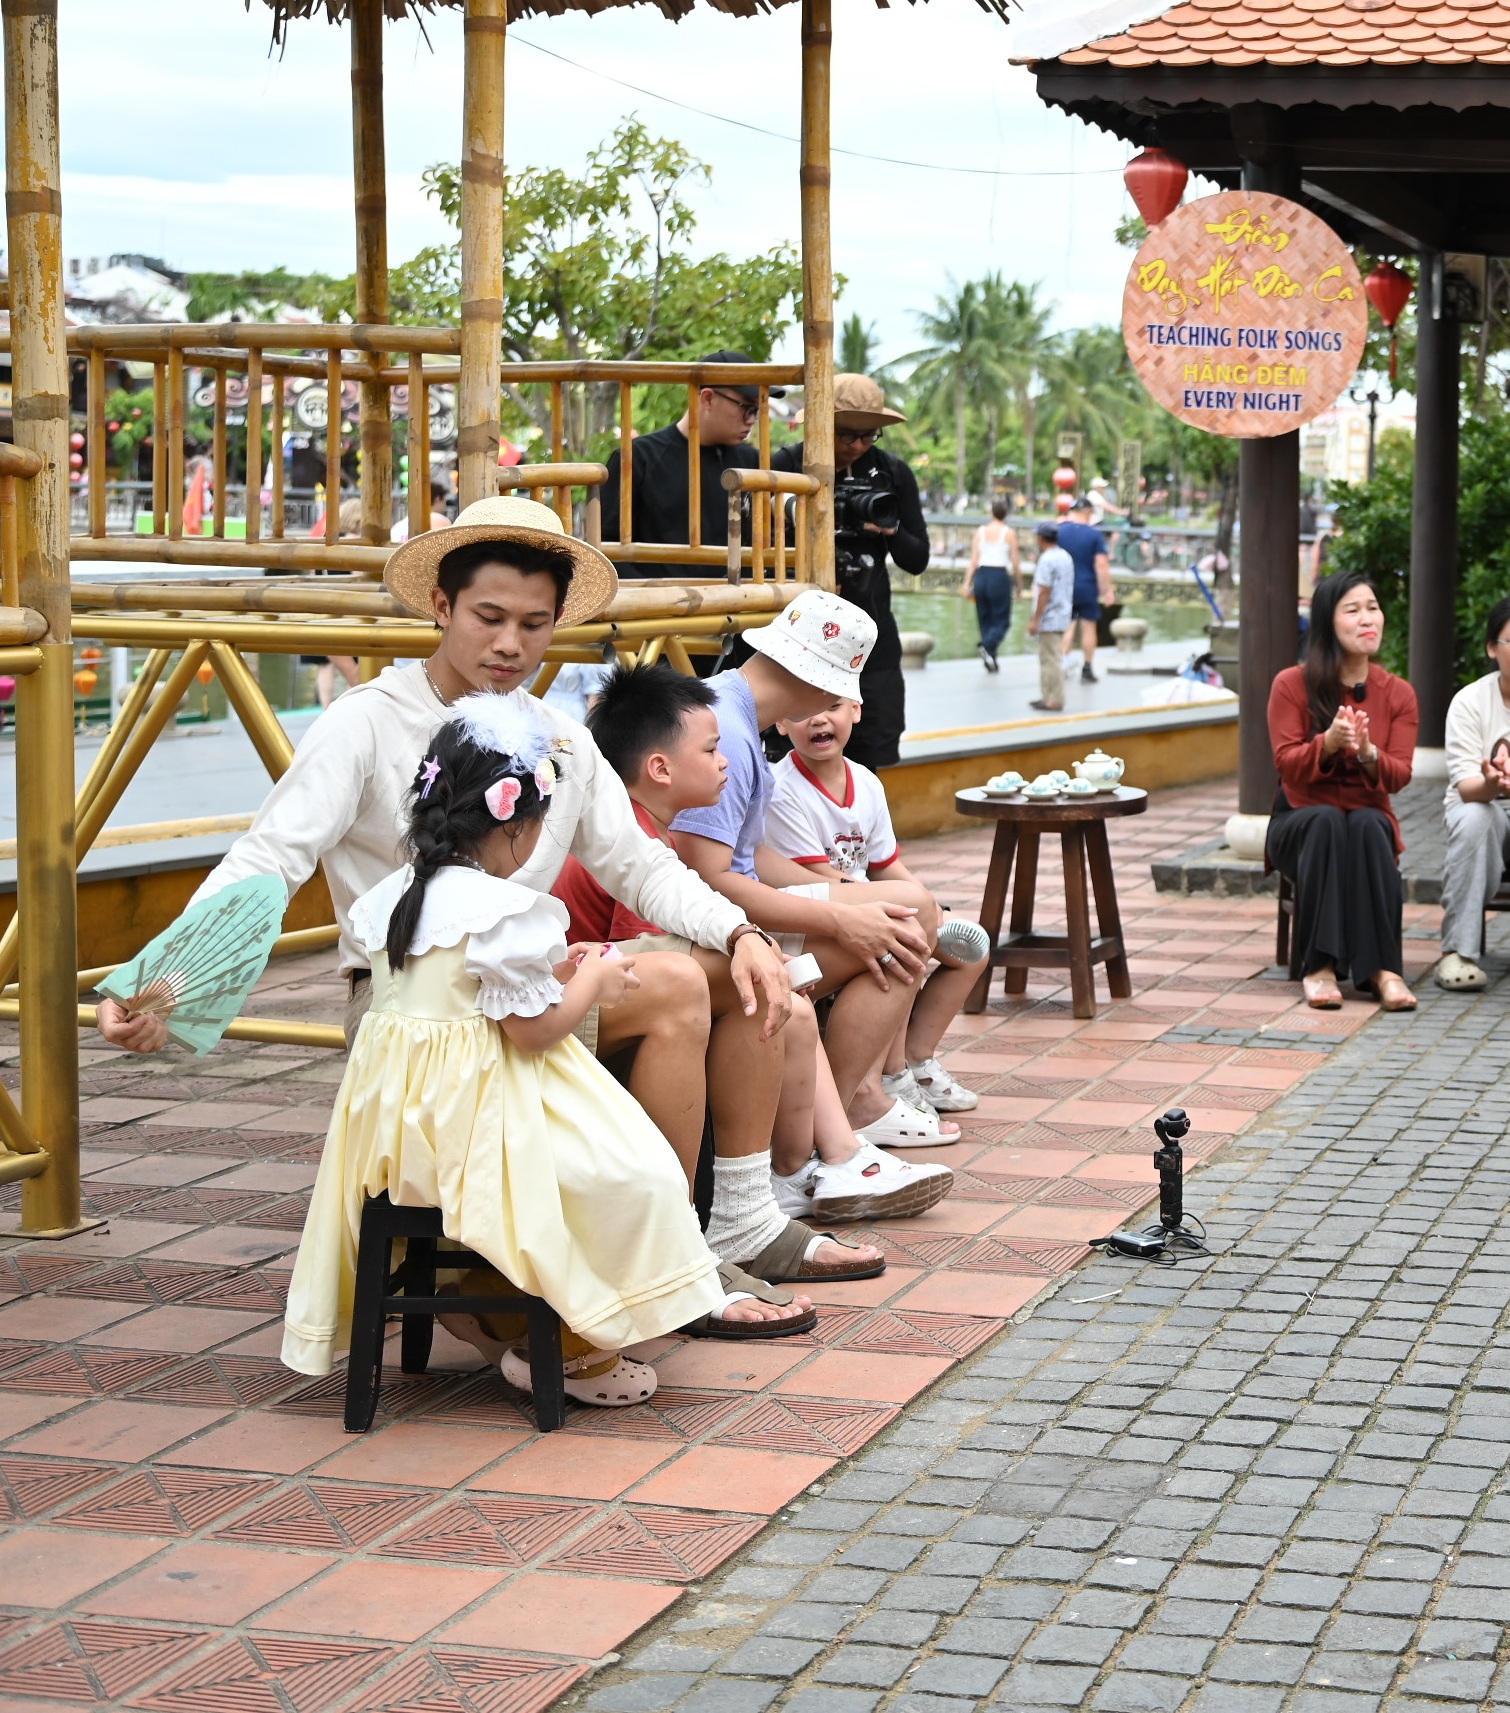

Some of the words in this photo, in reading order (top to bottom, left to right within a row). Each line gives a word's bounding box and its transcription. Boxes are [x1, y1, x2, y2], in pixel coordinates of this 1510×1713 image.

[1314, 265, 1354, 301] Ca
[1147, 324, 1231, 347] TEACHING
[1238, 328, 1278, 349] FOLK
[1285, 330, 1342, 351] SONGS
[1257, 361, 1307, 386] ĐÊM
[1184, 390, 1237, 409] EVERY
[1243, 392, 1302, 412] NIGHT
